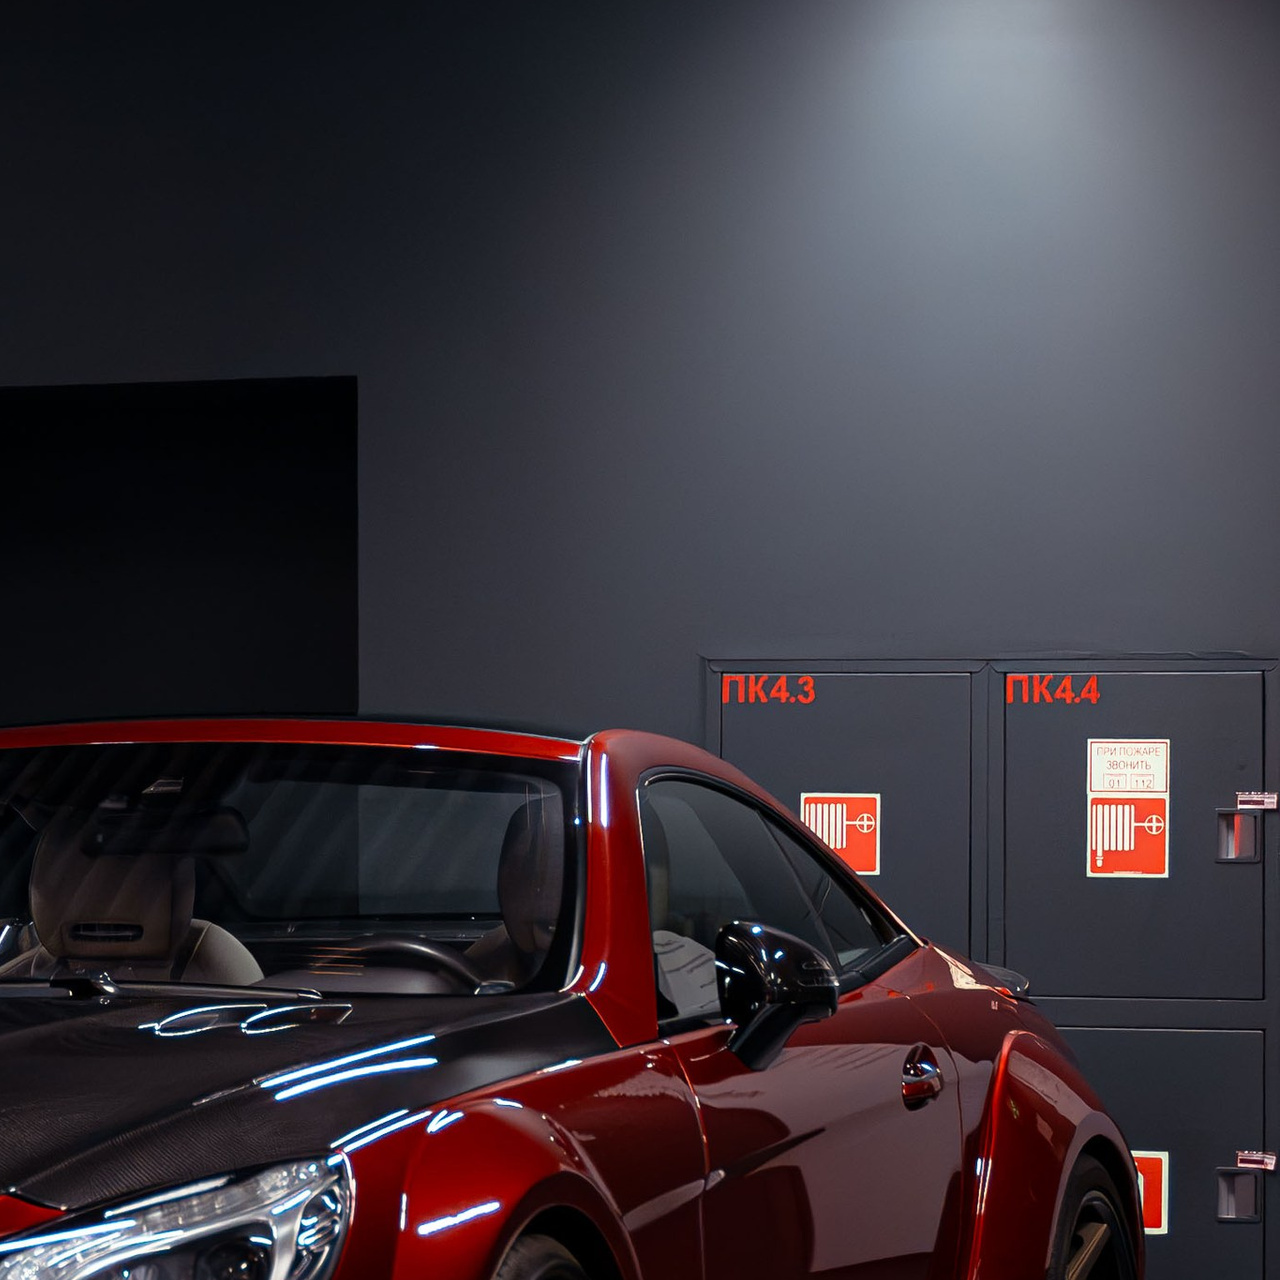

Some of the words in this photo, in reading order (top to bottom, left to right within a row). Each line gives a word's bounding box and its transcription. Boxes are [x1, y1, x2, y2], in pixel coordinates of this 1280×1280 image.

[722, 675, 815, 704] ПК4.3
[1006, 675, 1100, 704] ПК4.4
[1096, 747, 1117, 756] ПРИ
[1119, 747, 1161, 756] ПОЖАРЕ
[1106, 760, 1152, 770] ЗВОНИТЬ
[1108, 779, 1120, 789] 01
[1134, 779, 1152, 789] 112
